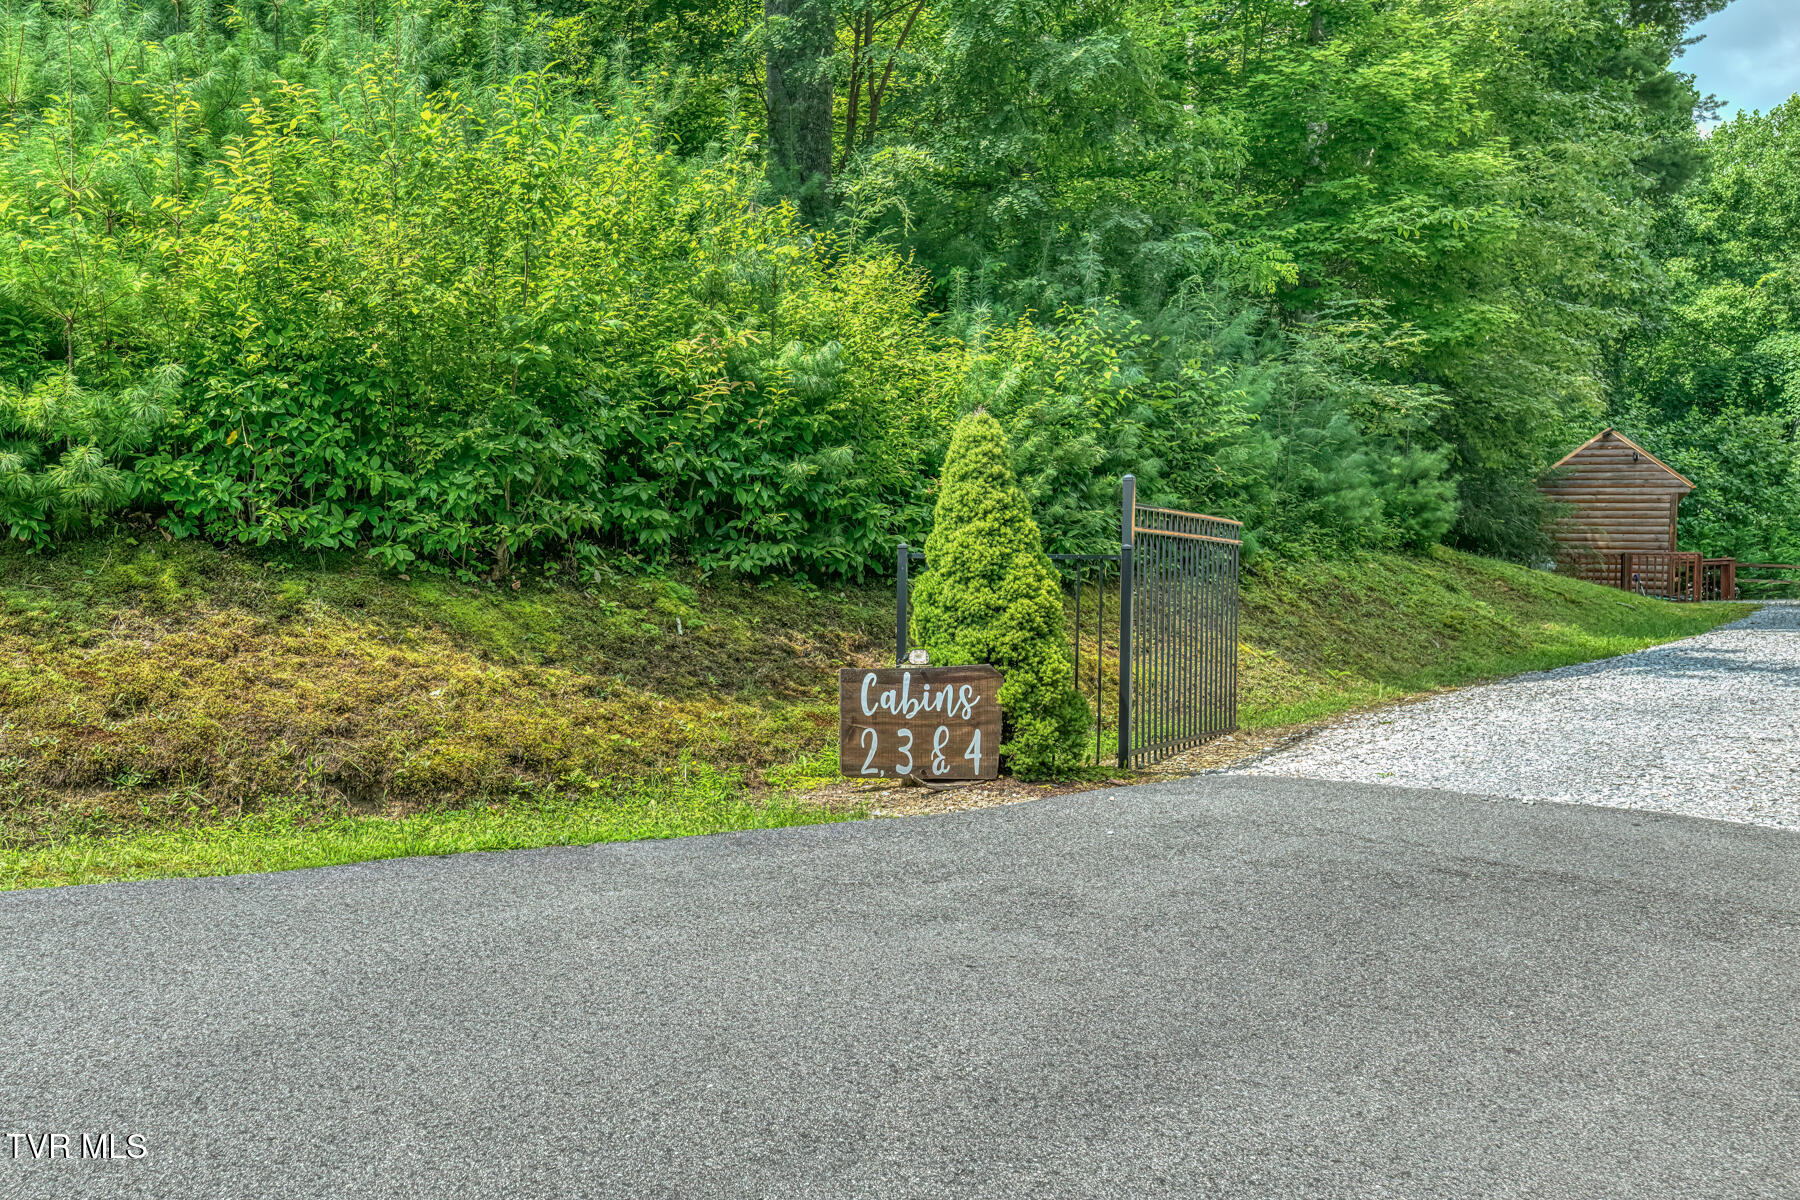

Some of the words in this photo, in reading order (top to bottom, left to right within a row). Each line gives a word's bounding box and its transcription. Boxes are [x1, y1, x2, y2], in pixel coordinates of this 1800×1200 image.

[861, 671, 981, 720] Cabins
[895, 728, 914, 775] 3
[931, 725, 950, 776] &
[964, 728, 982, 776] 4
